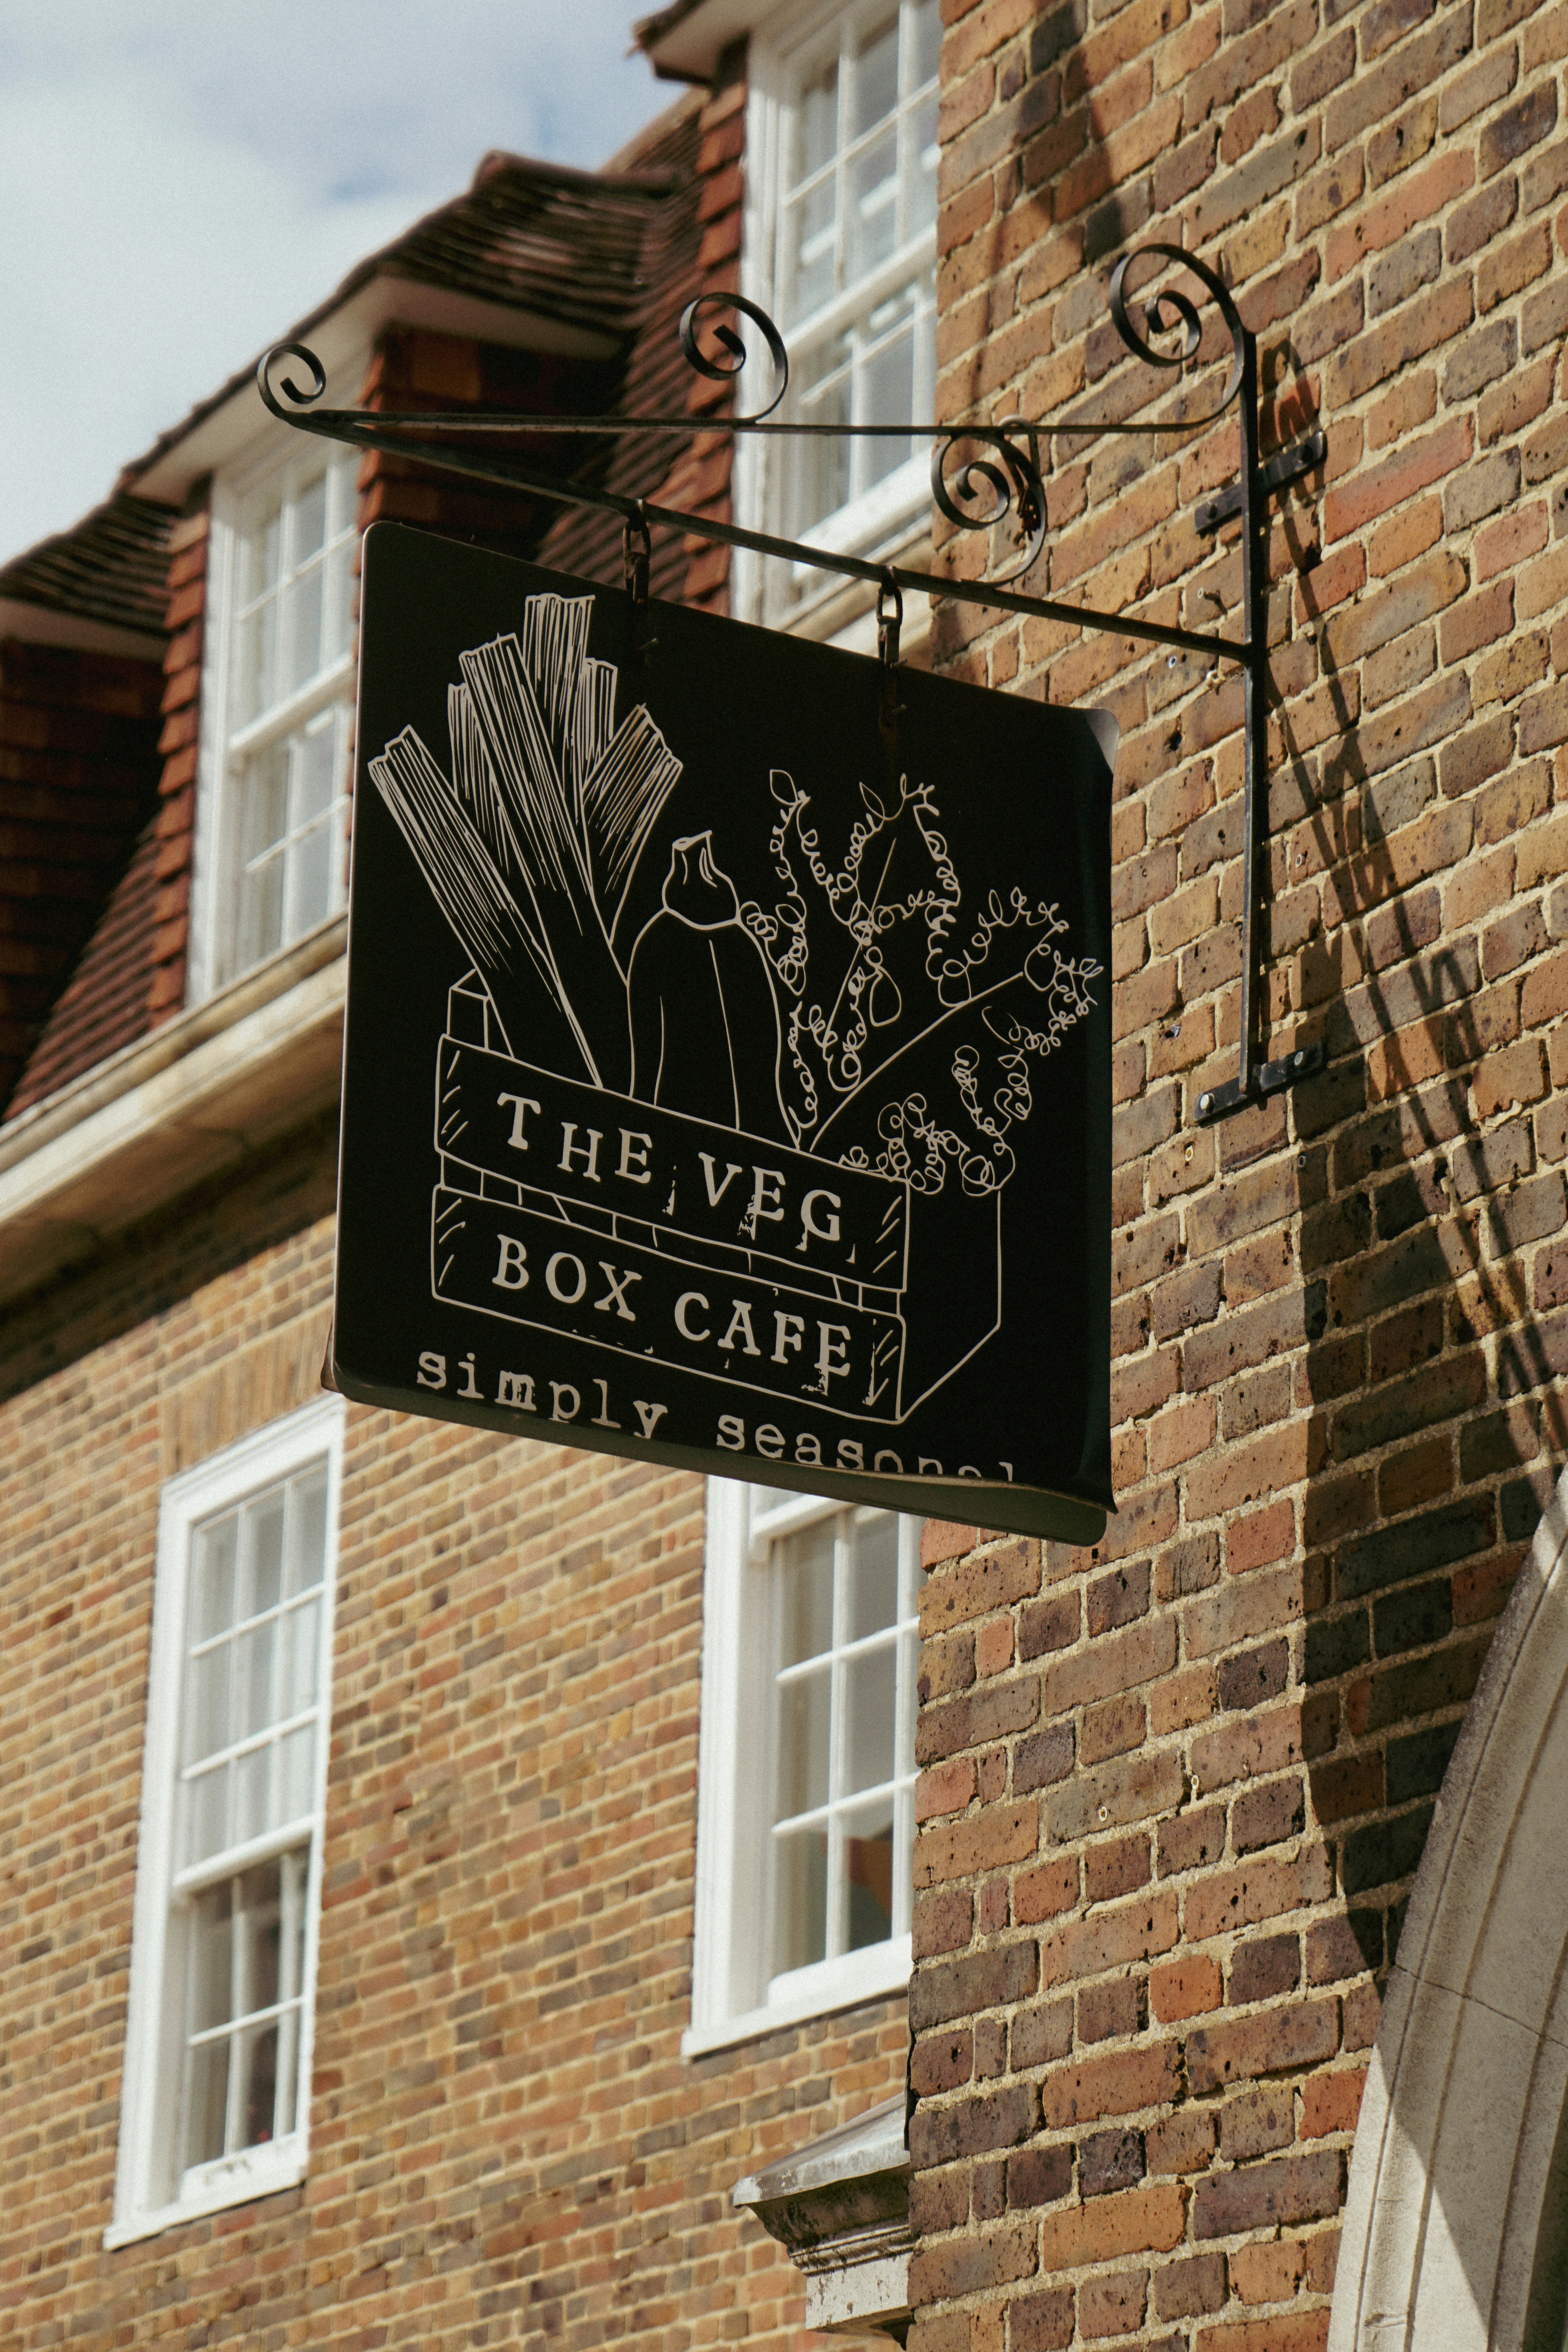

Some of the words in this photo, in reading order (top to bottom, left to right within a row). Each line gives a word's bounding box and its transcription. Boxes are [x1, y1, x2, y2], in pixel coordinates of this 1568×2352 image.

[497, 1092, 652, 1183] THE
[698, 1152, 841, 1241] VEG
[492, 1234, 642, 1321] BOX
[674, 1292, 851, 1377] CAFE
[417, 1352, 668, 1439] simply
